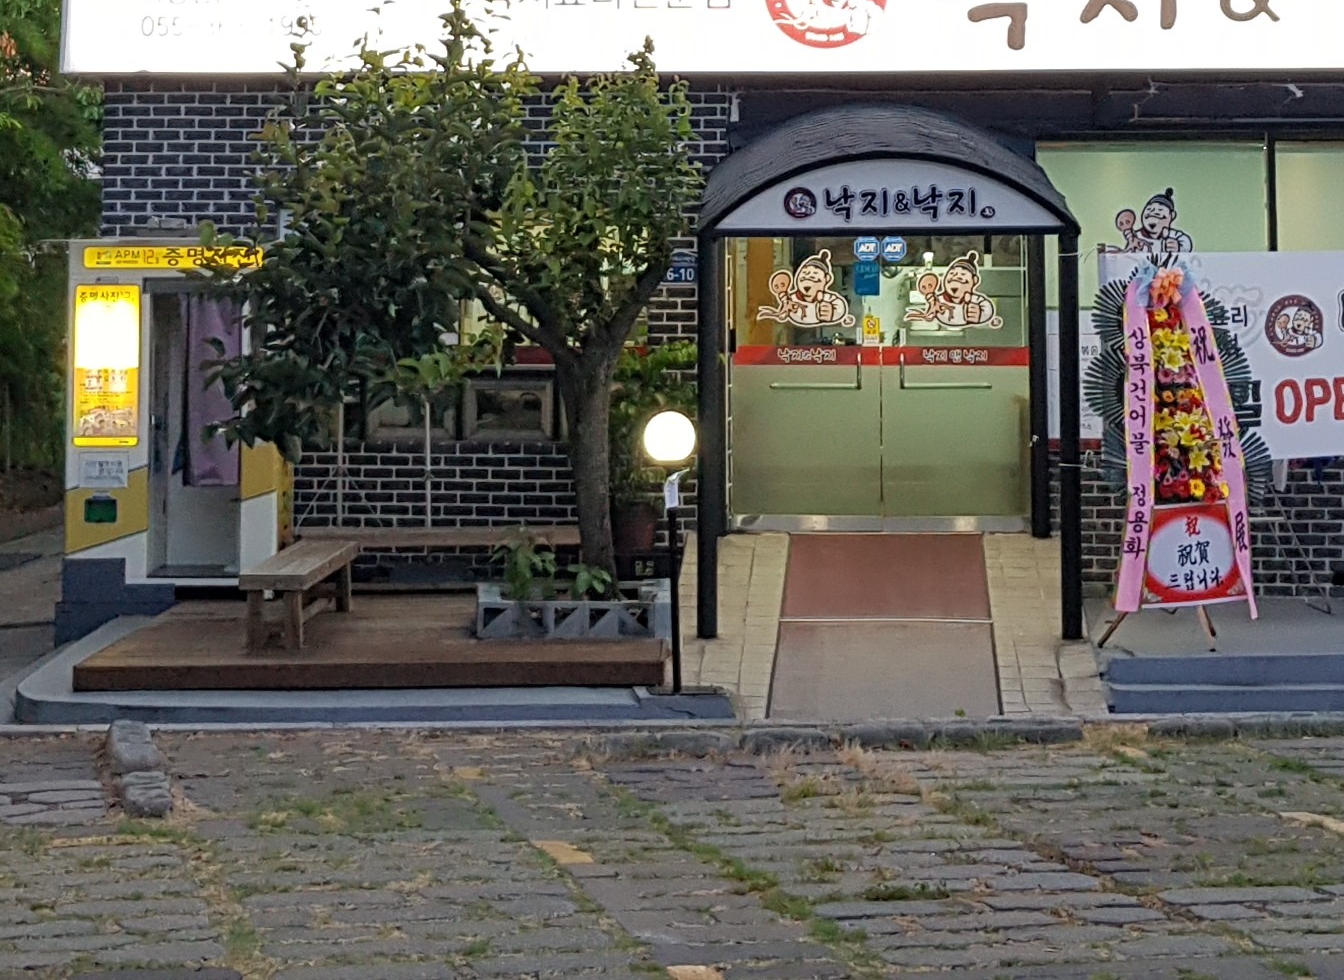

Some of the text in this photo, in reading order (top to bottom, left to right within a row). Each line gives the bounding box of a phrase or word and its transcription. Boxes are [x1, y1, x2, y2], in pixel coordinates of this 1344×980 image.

[824, 185, 977, 221] 낙지&낙지
[858, 243, 876, 252] ADT
[884, 243, 903, 252] ADT
[666, 267, 695, 281] 6-10
[1123, 484, 1149, 560] 정용화
